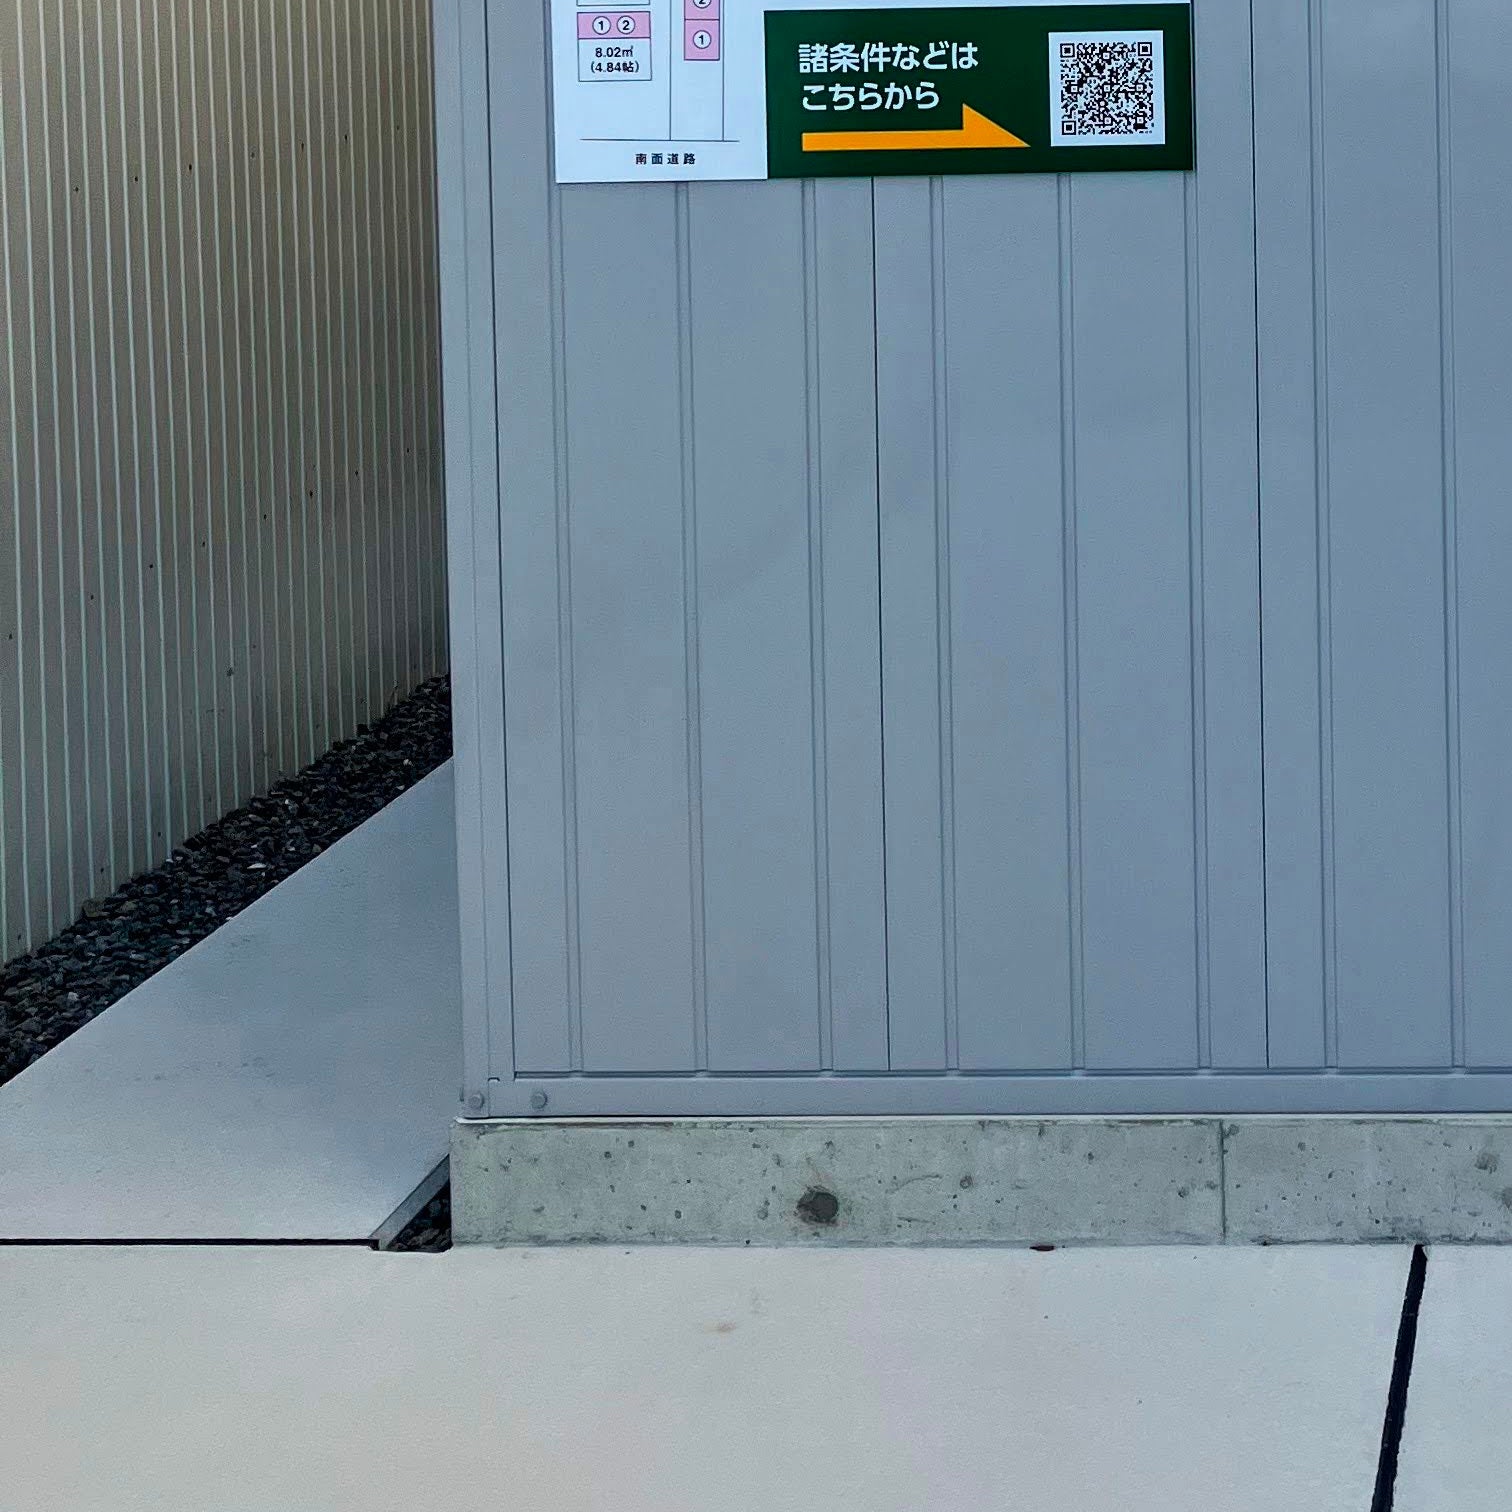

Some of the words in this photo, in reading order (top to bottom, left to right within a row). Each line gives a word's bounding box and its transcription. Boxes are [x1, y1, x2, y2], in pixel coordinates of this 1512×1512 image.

[799, 41, 979, 73] 諸条件などは
[801, 81, 940, 112] こちらから
